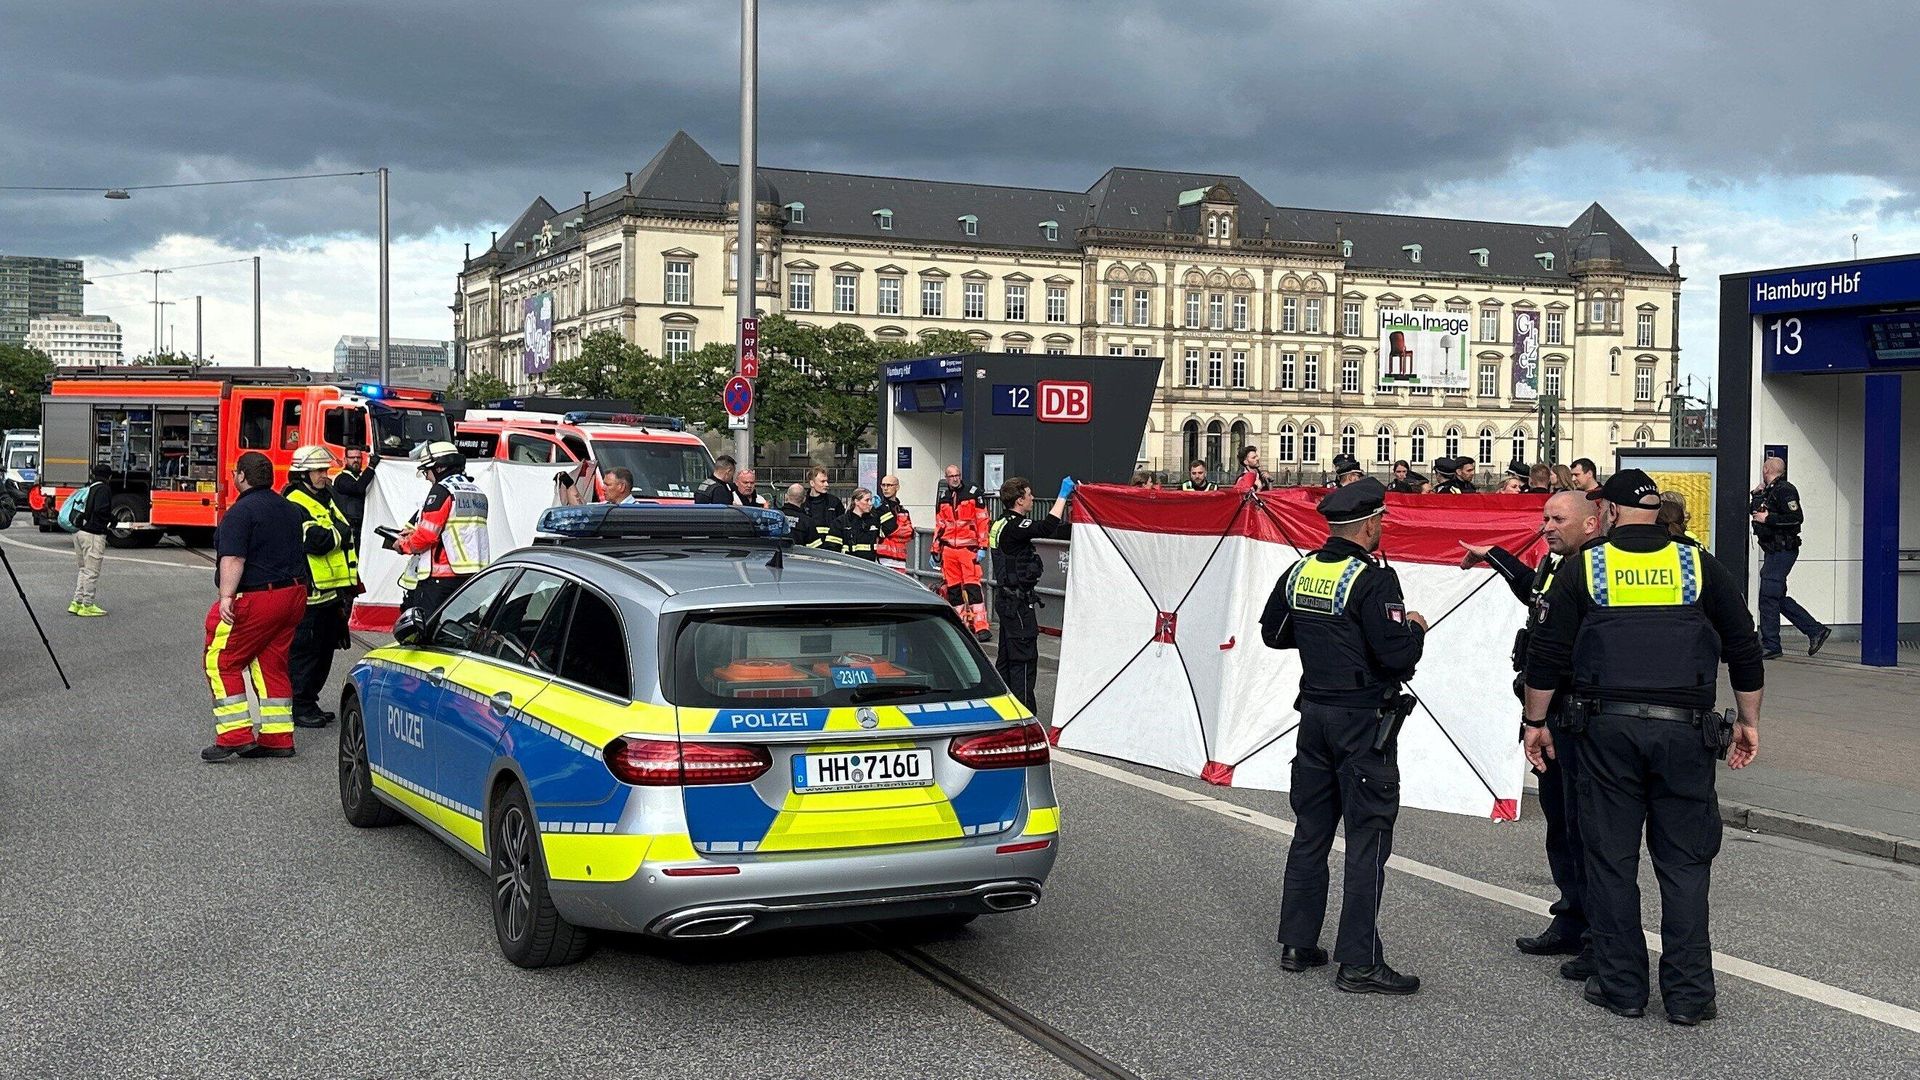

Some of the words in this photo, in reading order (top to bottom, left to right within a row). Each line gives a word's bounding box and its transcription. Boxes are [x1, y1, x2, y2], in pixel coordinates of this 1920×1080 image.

[1757, 278, 1826, 301] Hamburg
[1831, 272, 1861, 294] Hbf
[744, 321, 755, 330] 01
[1382, 312, 1420, 328] Hello
[1423, 313, 1469, 335] Image
[744, 338, 755, 347] 07
[1770, 318, 1802, 355] 13
[1008, 387, 1030, 408] 12
[1046, 388, 1085, 415] DB
[427, 423, 433, 432] 6
[1634, 484, 1659, 496] POLIZ
[1297, 576, 1336, 596] POLIZEI
[1615, 569, 1674, 586] POLIZEI
[839, 671, 869, 684] 23/10
[388, 704, 425, 750] POLIZEI
[731, 712, 809, 729] POLIZEI
[798, 775, 803, 783] D
[818, 756, 849, 783] HH
[864, 753, 920, 780] 7160
